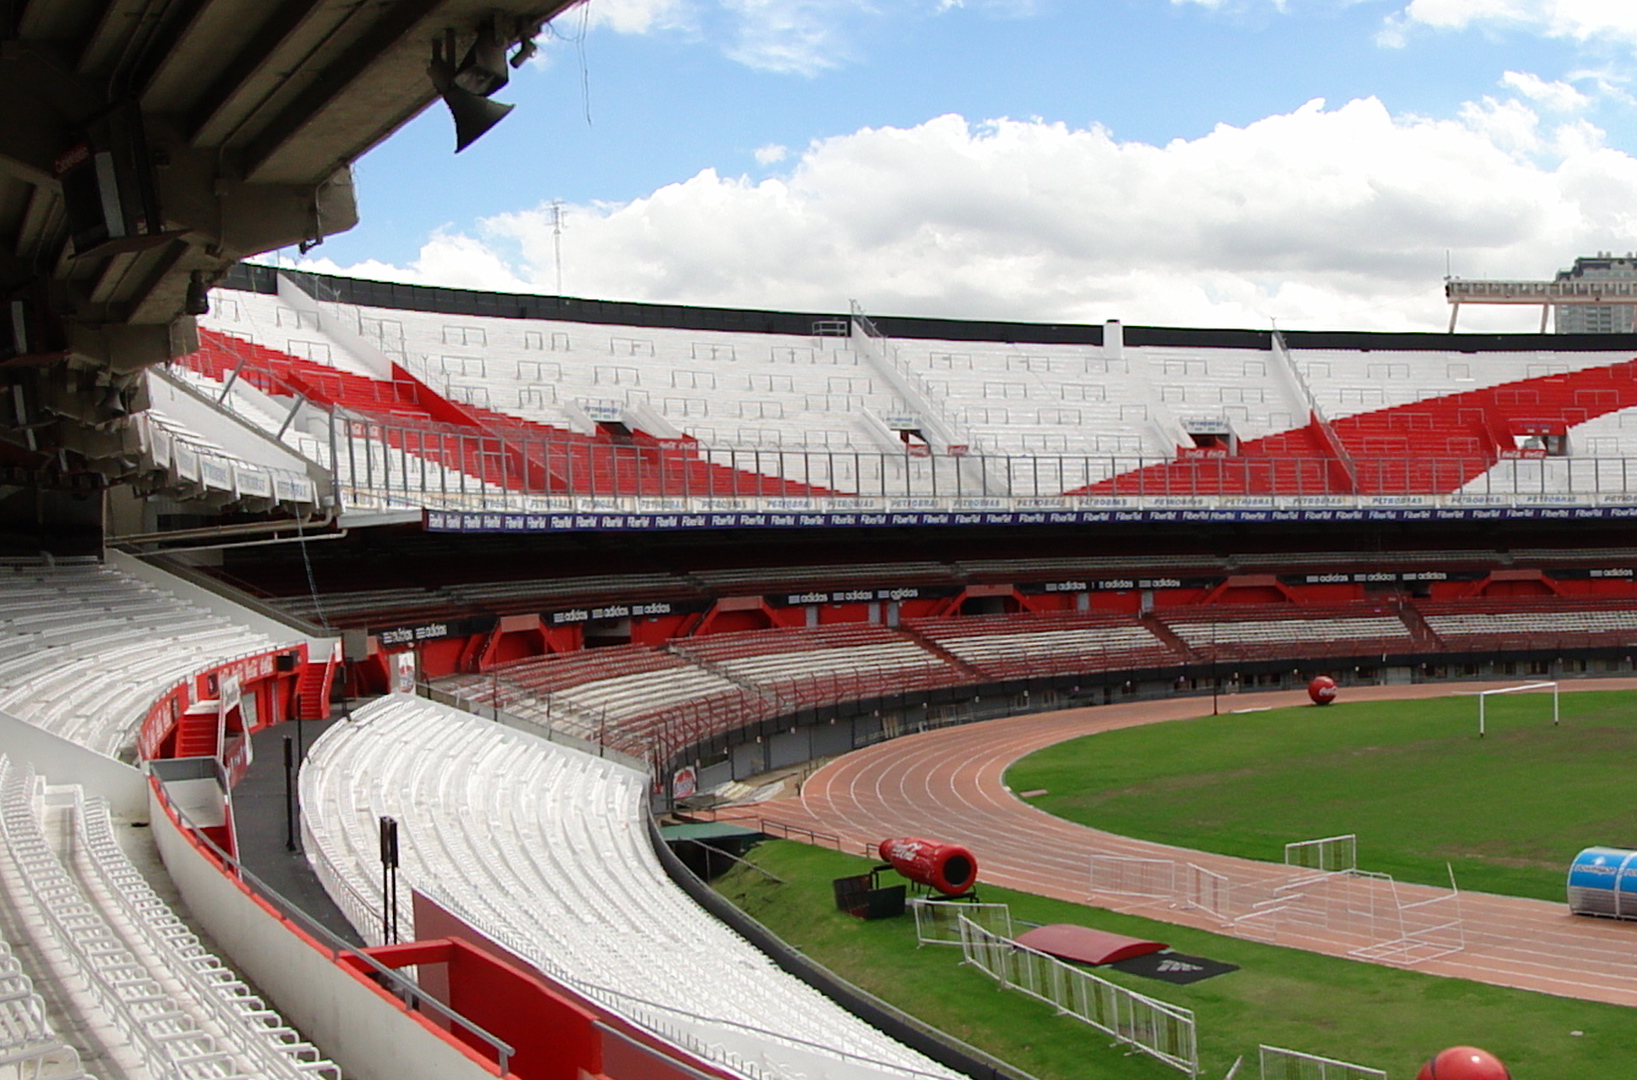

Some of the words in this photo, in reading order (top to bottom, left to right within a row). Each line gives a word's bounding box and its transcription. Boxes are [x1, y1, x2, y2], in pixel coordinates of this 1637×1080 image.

[1320, 574, 1348, 582] adidas
[1367, 573, 1396, 581] adidas
[1418, 572, 1446, 580] adidas
[1058, 581, 1086, 590] adidas
[1105, 579, 1133, 589] adidas
[1152, 579, 1180, 587] adidas
[801, 592, 828, 603] adidas
[602, 606, 628, 617] adidas
[643, 603, 670, 614] adidas
[564, 610, 587, 621] adidas
